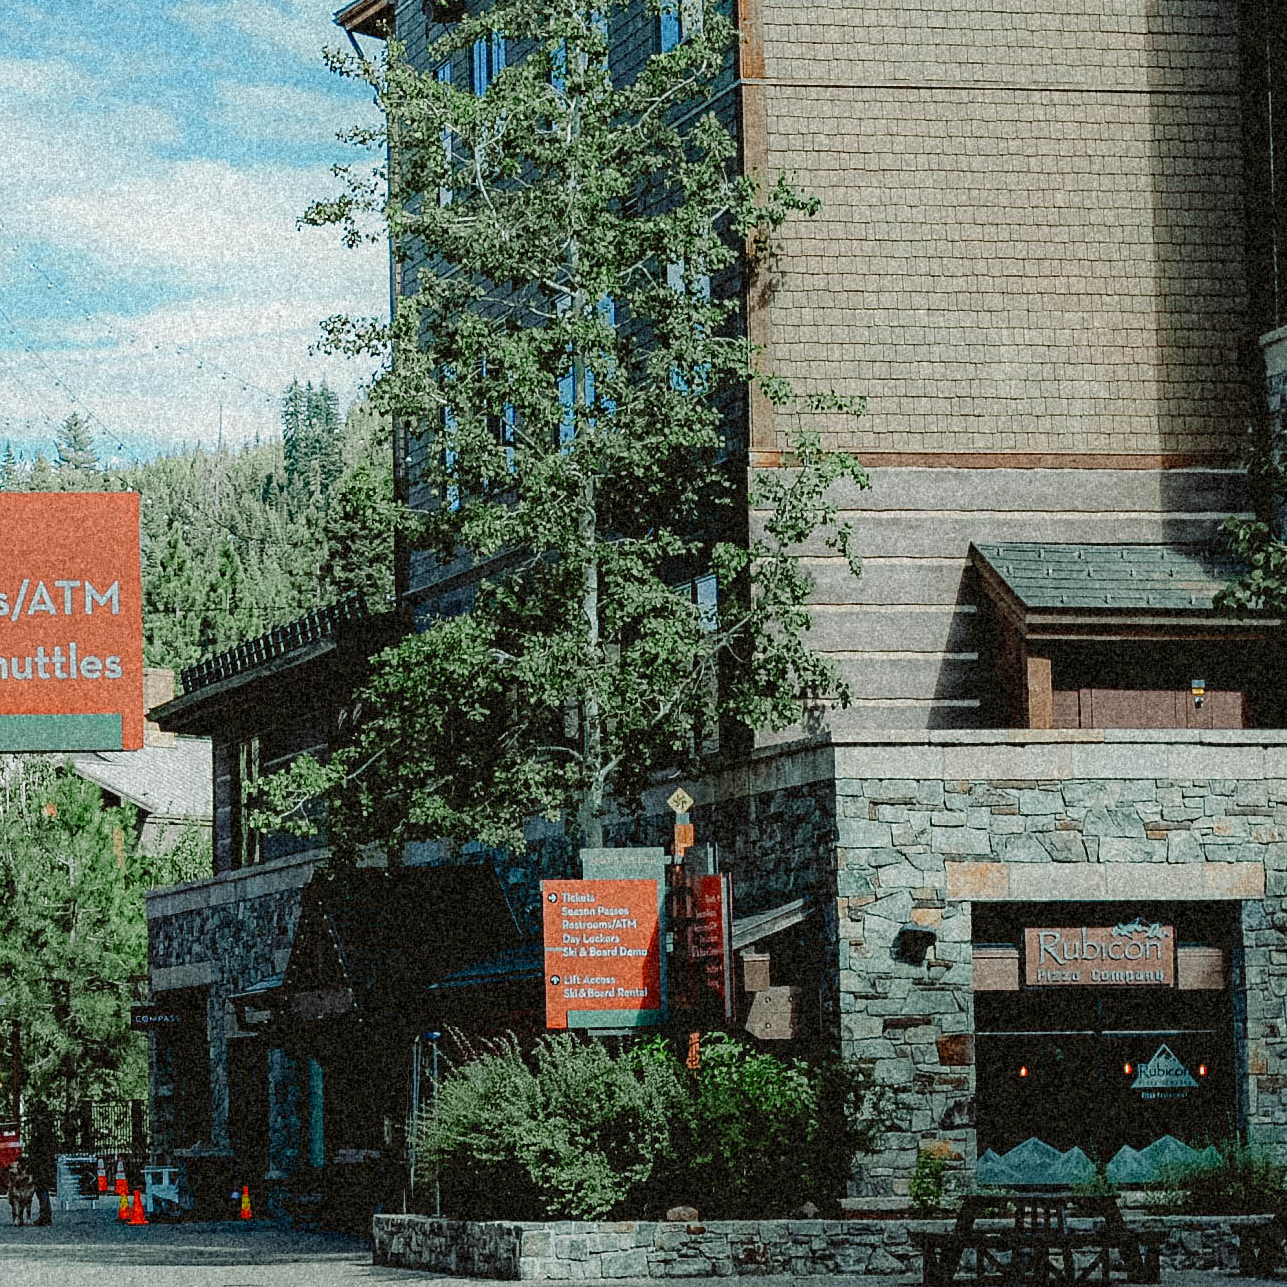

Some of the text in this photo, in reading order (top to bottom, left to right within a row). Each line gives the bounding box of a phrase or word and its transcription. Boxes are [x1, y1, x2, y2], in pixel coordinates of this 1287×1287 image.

[561, 892, 595, 903] Tickets
[561, 905, 630, 916] Season Passes
[562, 918, 637, 930] Restrooms/ATM
[562, 933, 620, 945] Day Lockers
[562, 946, 648, 957] Ski & Board Demo
[1038, 927, 1162, 965] Rubicon
[563, 975, 616, 985] Lift Access
[1037, 969, 1165, 983] Pizza Company
[563, 988, 578, 998] Ski
[587, 987, 615, 998] Board
[617, 986, 648, 997] Rental
